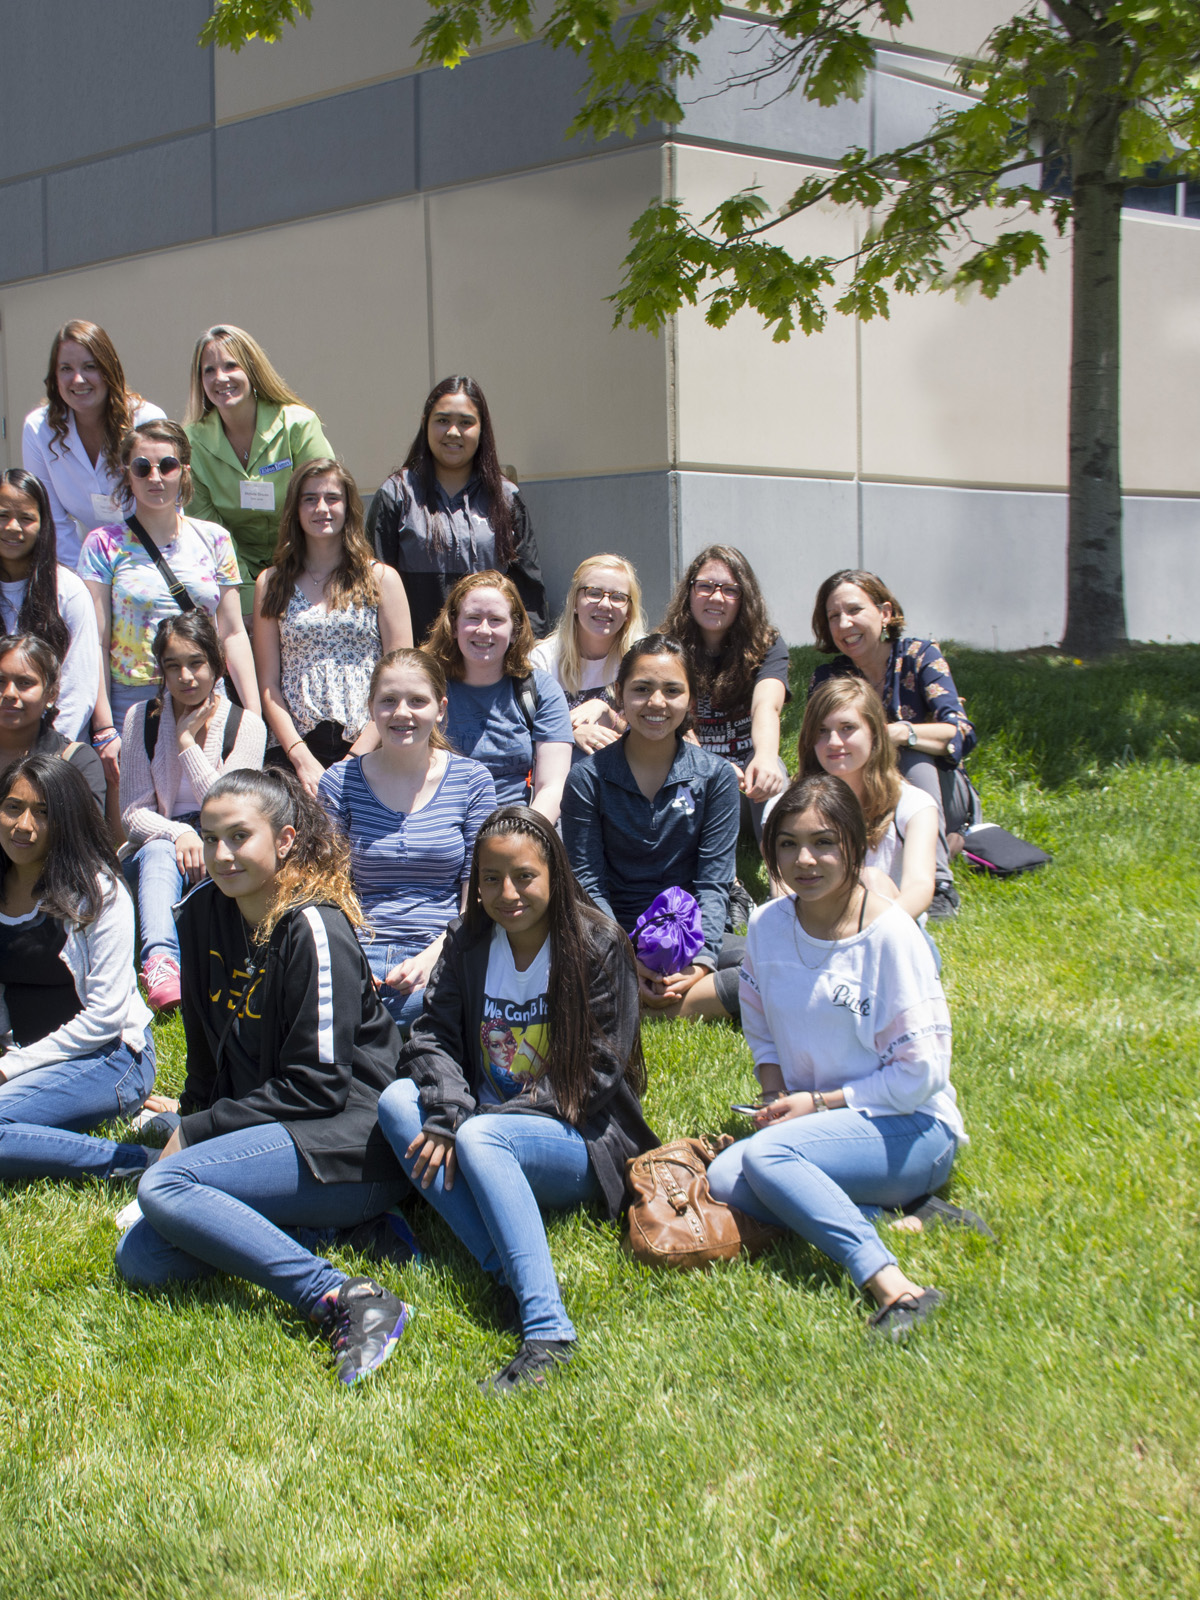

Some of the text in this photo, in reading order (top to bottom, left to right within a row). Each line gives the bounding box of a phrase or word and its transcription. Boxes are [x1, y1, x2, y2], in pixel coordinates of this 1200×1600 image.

[701, 738, 753, 753] ORK CIT
[484, 998, 503, 1019] We
[504, 1003, 530, 1022] Can
